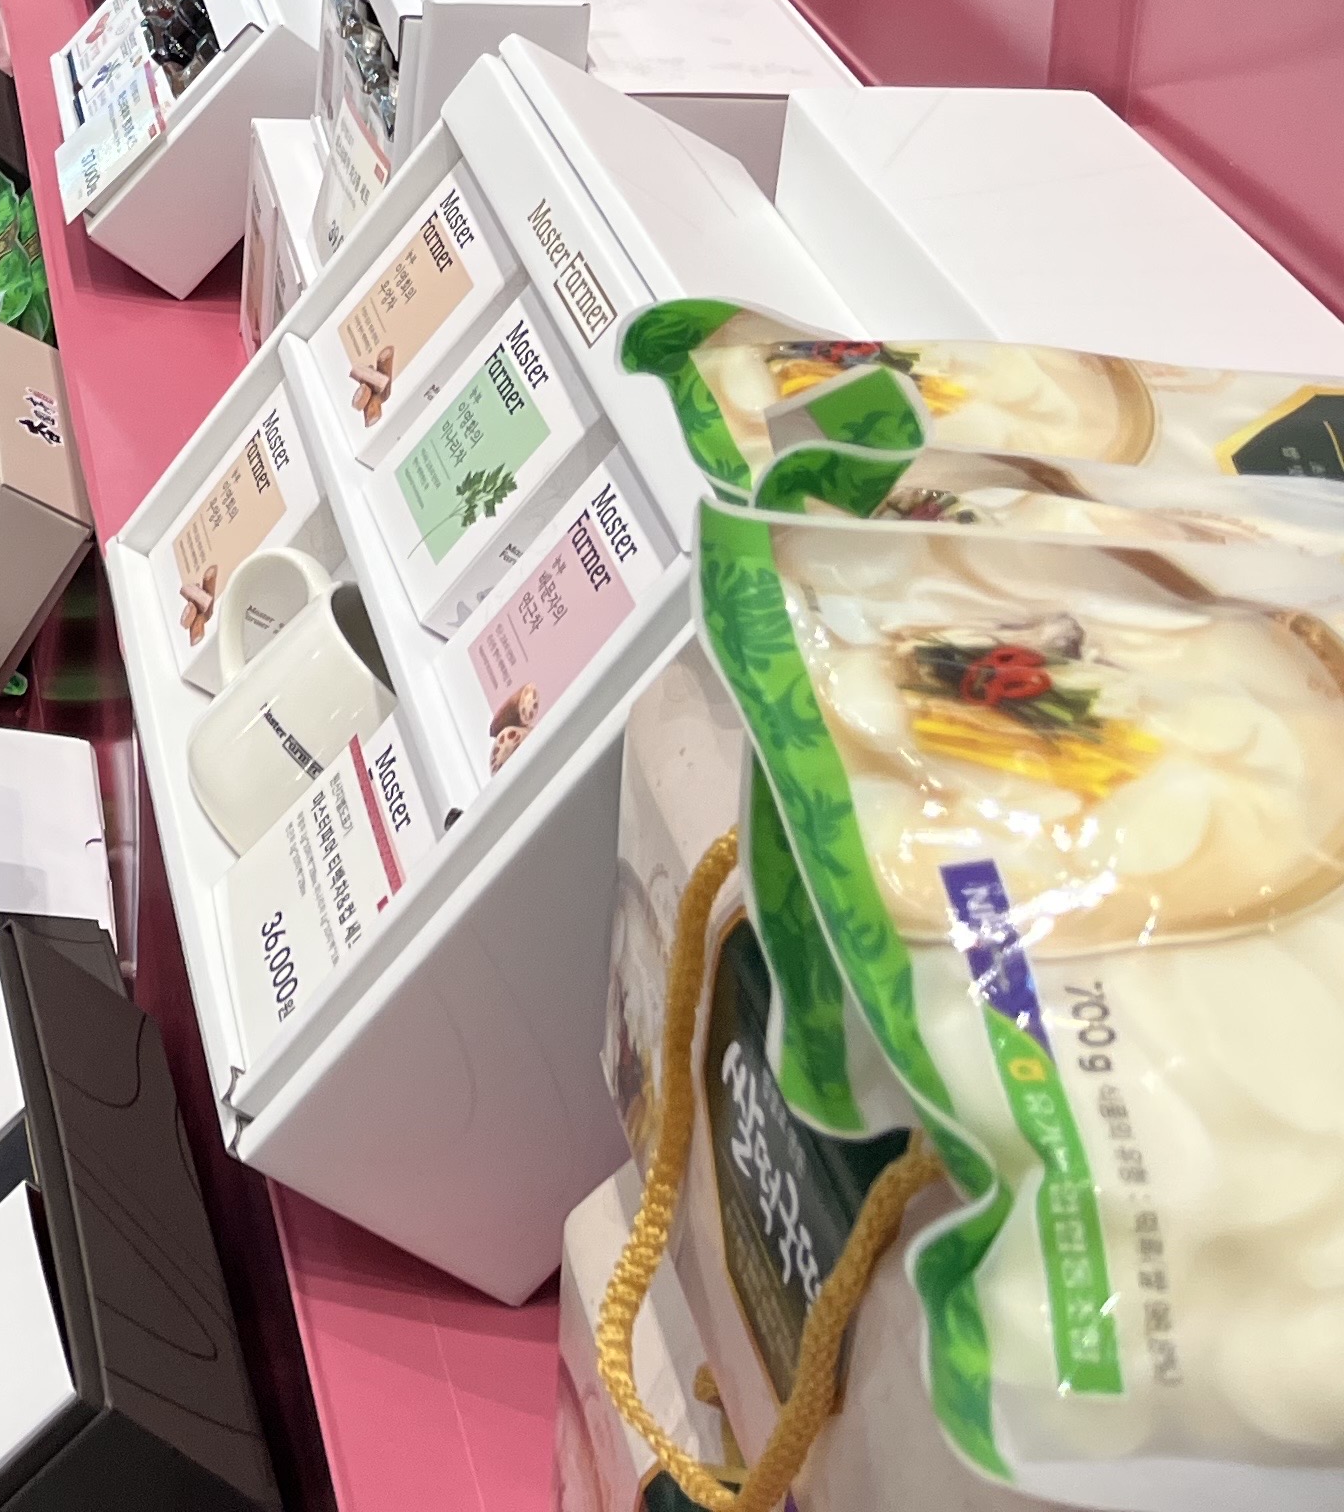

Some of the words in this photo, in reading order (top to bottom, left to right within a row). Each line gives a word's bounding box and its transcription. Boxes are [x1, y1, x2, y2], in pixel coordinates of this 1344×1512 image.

[421, 212, 452, 272] Farmer
[440, 190, 473, 248] Master
[526, 198, 572, 272] Master
[559, 251, 610, 334] Farmer
[486, 344, 524, 414] Farmer
[507, 321, 548, 387] Master
[246, 430, 278, 493] Farmer
[257, 410, 289, 469] Master
[441, 421, 466, 467] 미나리차
[569, 511, 610, 590] Farmer
[592, 484, 636, 561] Master
[519, 592, 543, 634] 연근차
[375, 744, 412, 832] Master
[312, 791, 337, 858] 마스터파머
[328, 854, 355, 924] 티백차&컵
[262, 912, 297, 1019] 36,000원
[1063, 980, 1118, 1075] 700g
